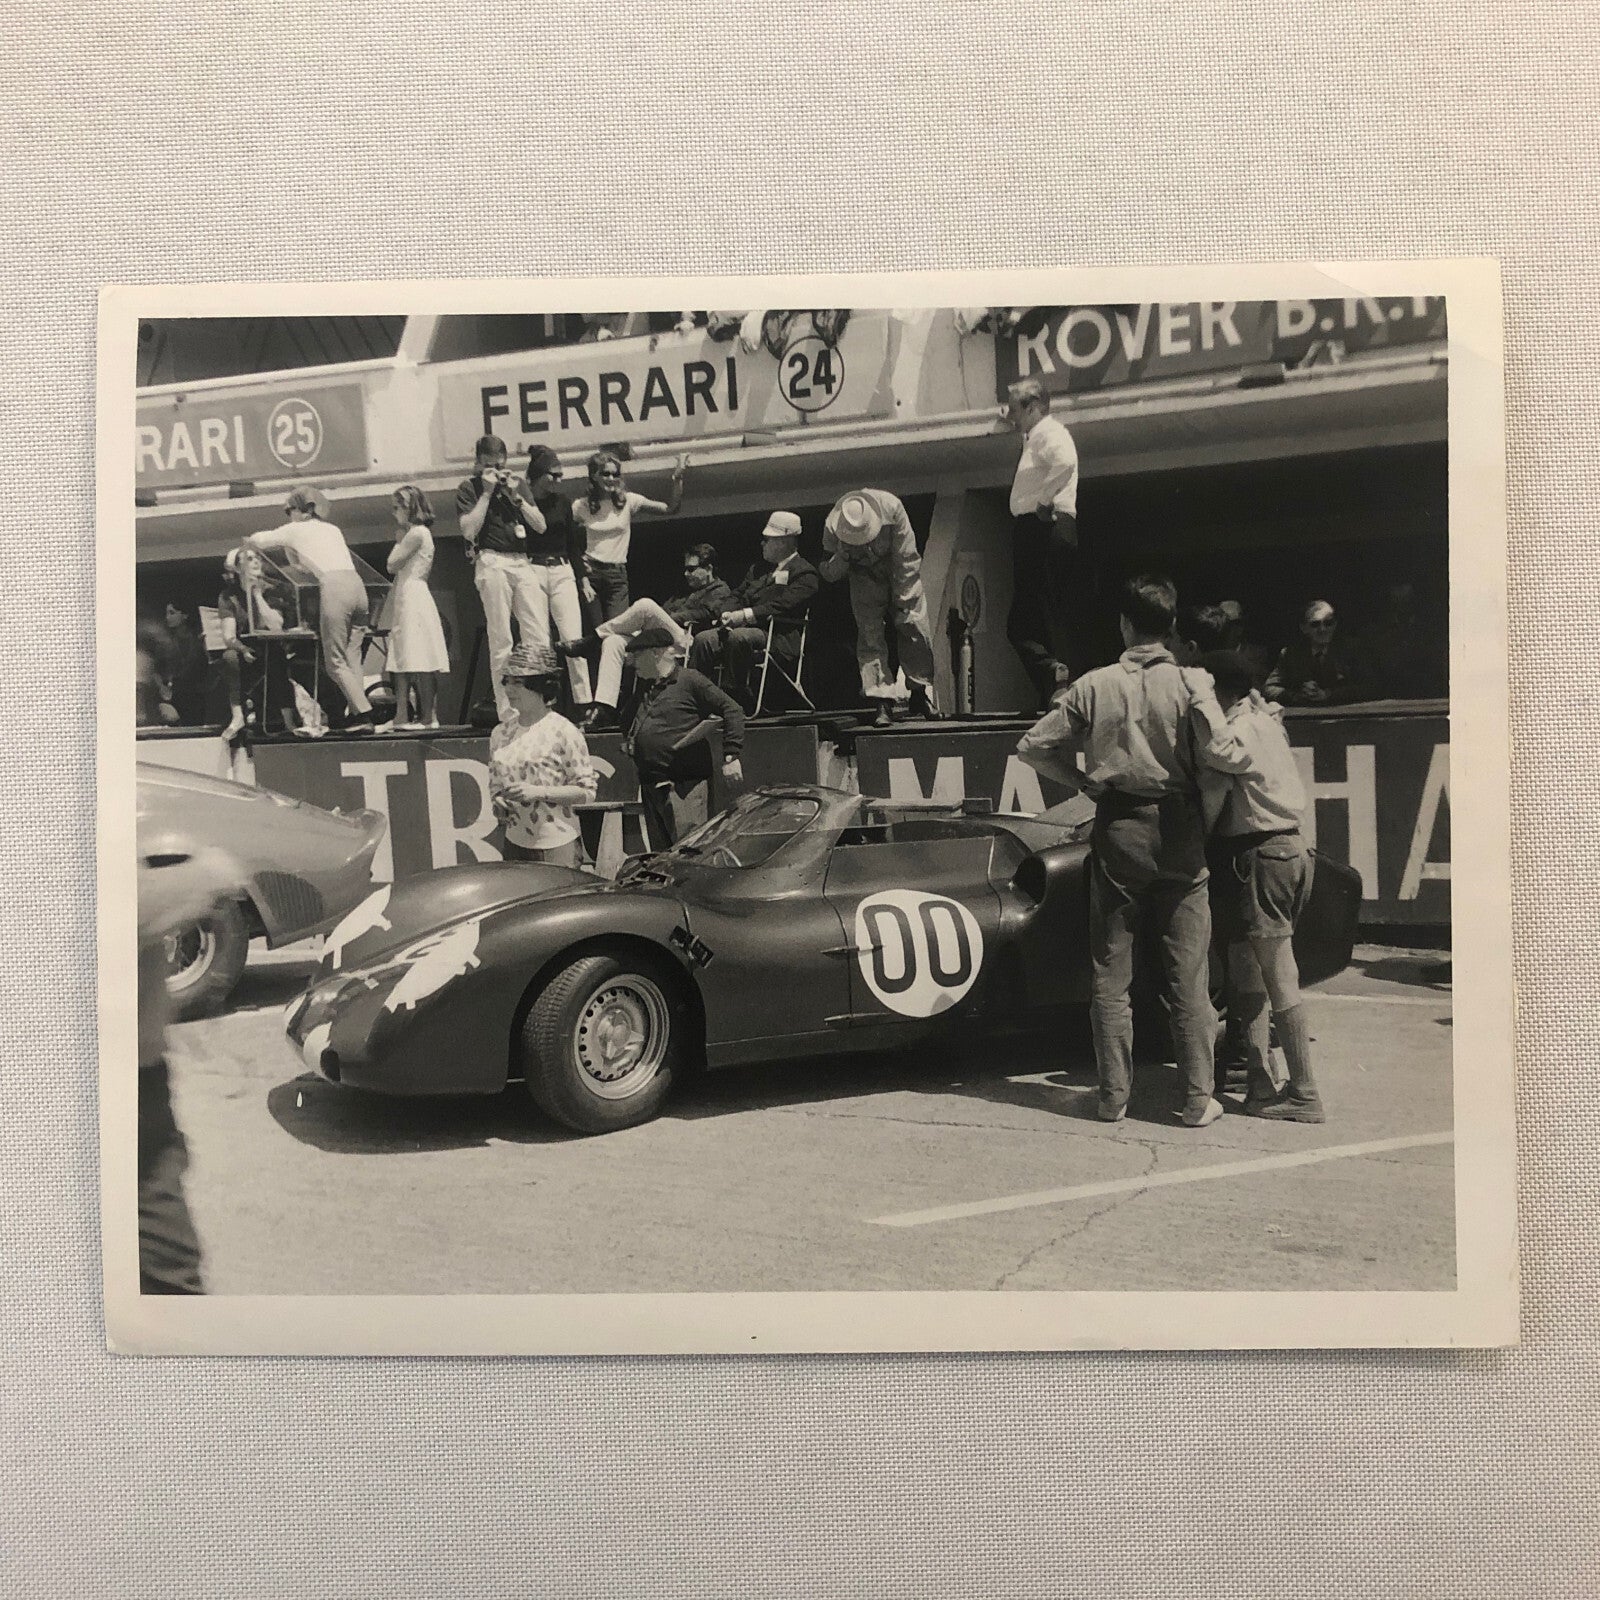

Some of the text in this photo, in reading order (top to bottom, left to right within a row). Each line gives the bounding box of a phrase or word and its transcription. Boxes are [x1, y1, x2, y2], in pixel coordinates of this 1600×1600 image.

[1017, 302, 1241, 377] ROVER
[481, 349, 837, 435] FERRARI 24
[137, 412, 315, 473] RARI 25
[862, 899, 972, 994] 00
